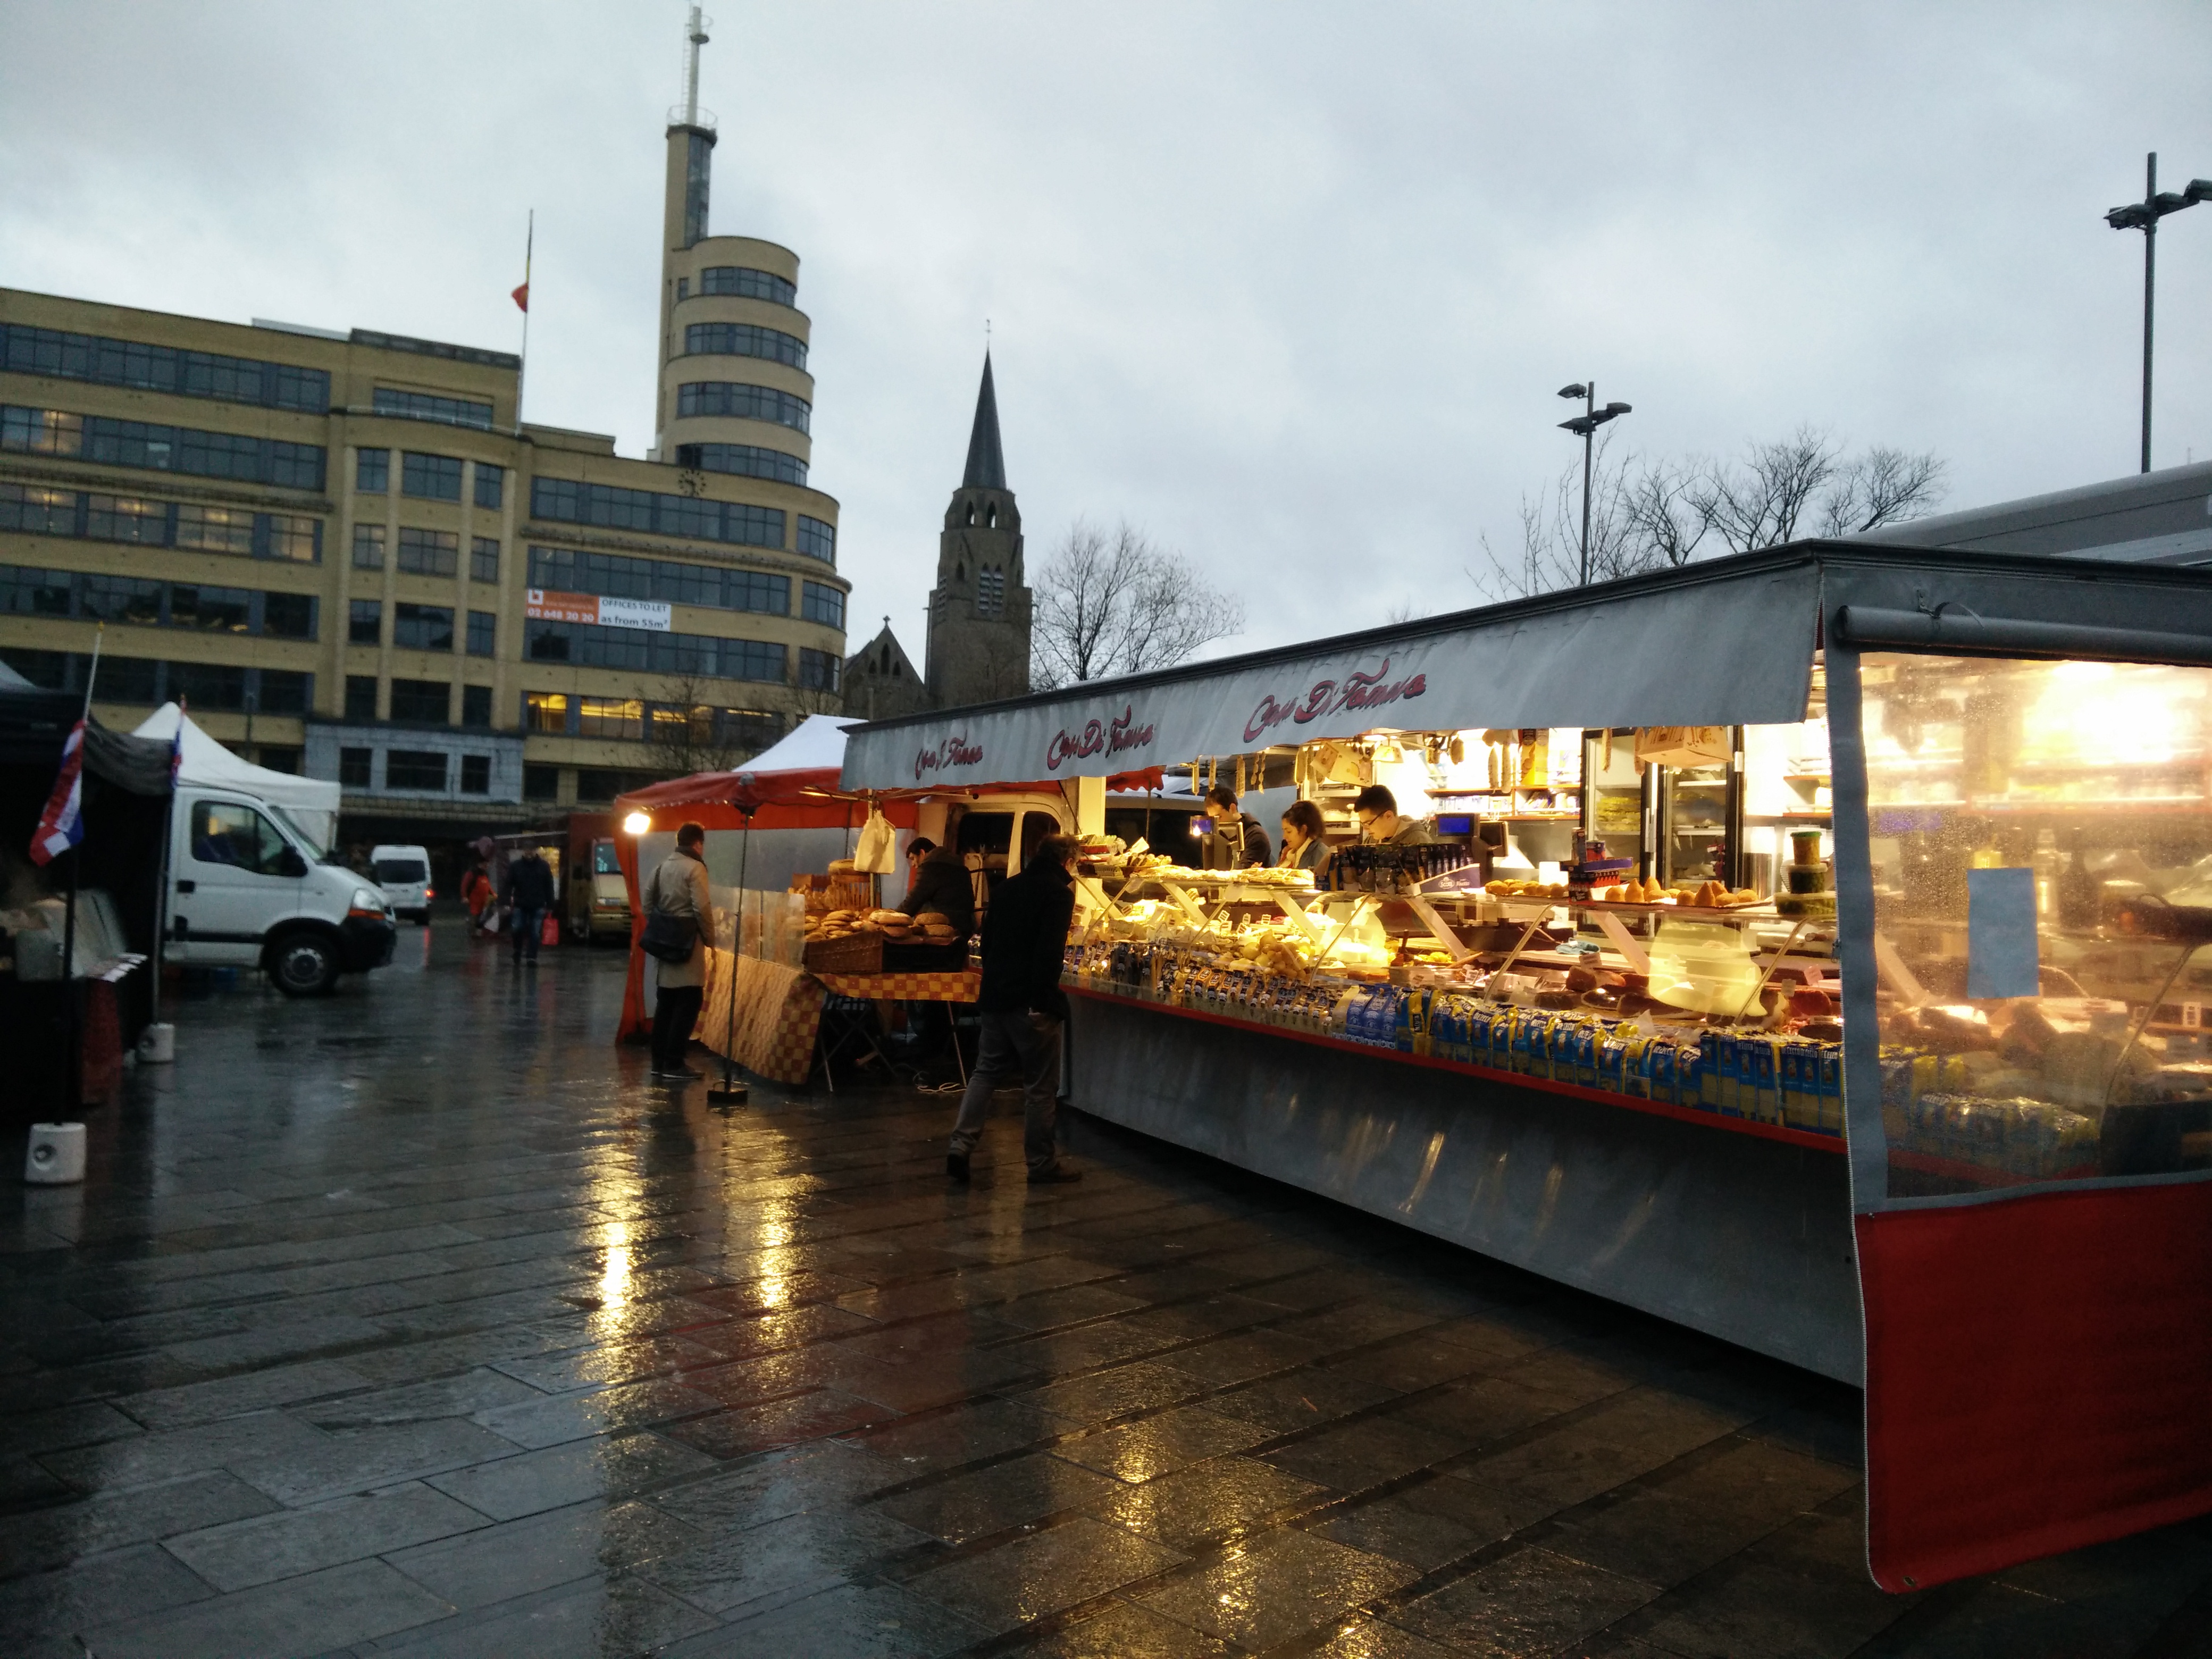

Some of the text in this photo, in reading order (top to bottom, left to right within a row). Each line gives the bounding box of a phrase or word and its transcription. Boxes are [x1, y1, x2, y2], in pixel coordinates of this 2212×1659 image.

[602, 600, 638, 609] OFFICES
[639, 602, 650, 611] TO
[528, 607, 541, 617] 02
[615, 615, 639, 626] from
